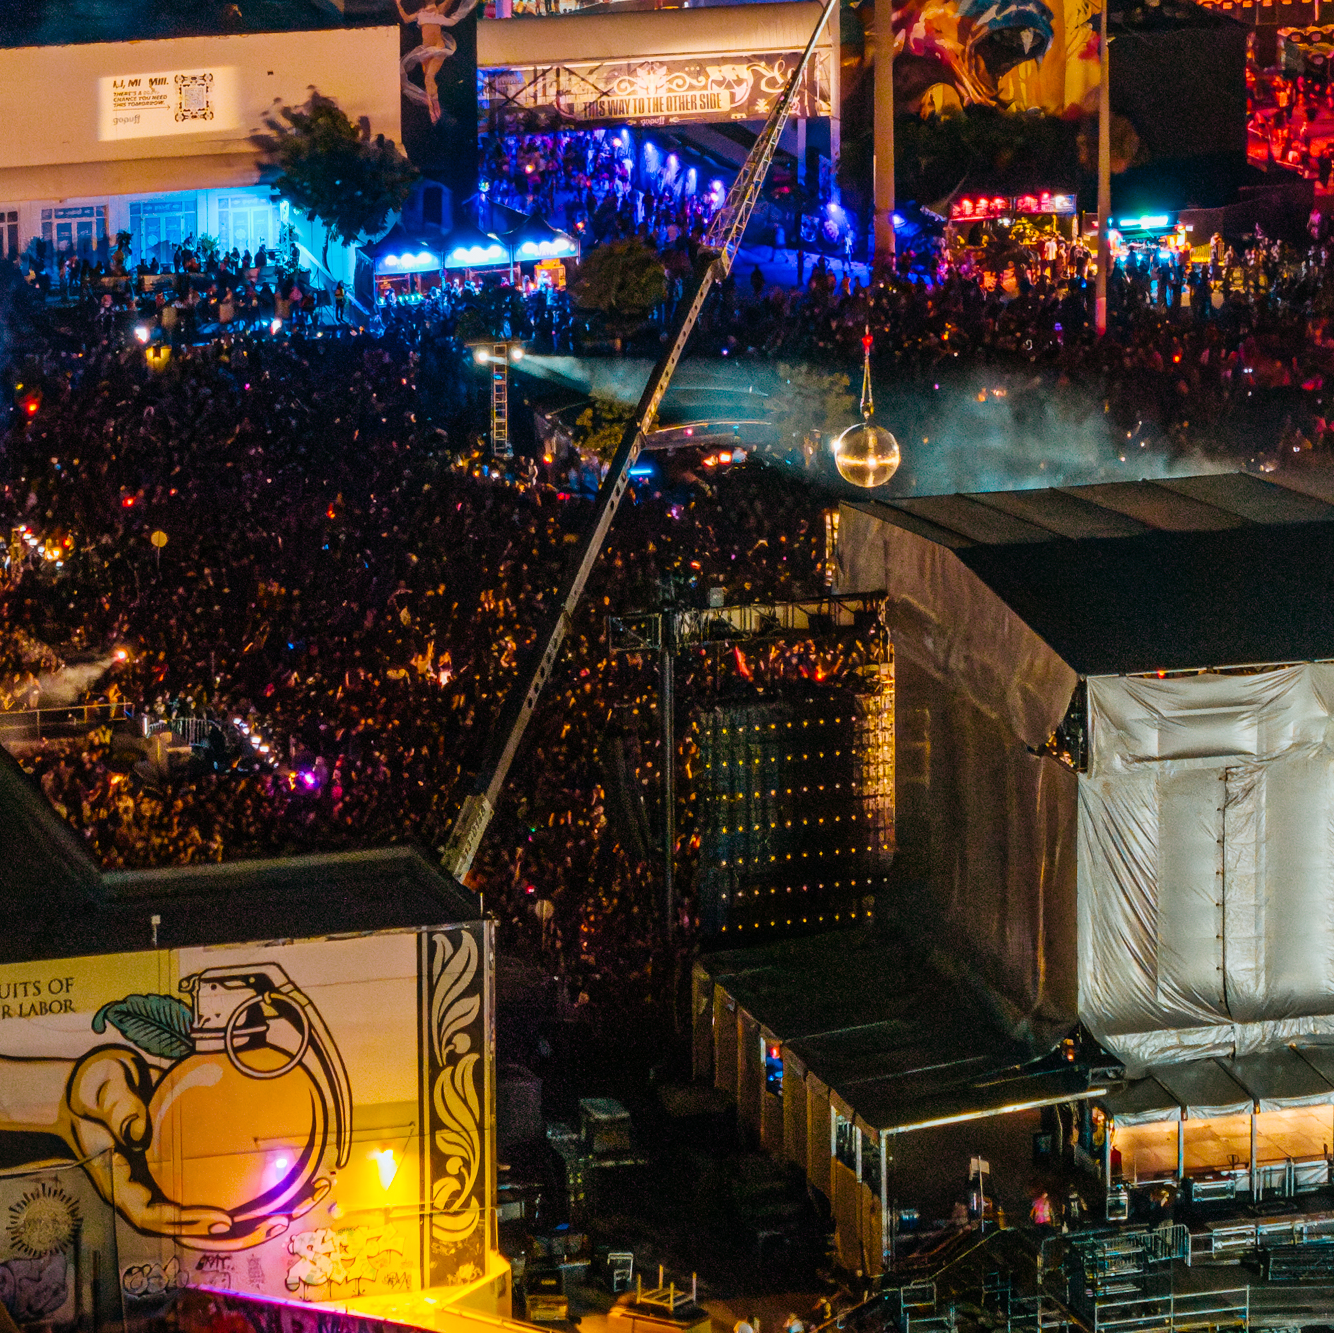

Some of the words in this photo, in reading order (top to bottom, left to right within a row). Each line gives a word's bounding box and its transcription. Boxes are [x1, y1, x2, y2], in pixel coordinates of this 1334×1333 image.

[607, 98, 630, 116] WAY
[632, 97, 645, 114] TO
[646, 95, 665, 113] THE
[666, 94, 697, 112] OTHER
[698, 92, 722, 110] SIDE
[113, 114, 141, 125] gopuff
[48, 977, 75, 995] OF
[19, 999, 76, 1018] LABOR
